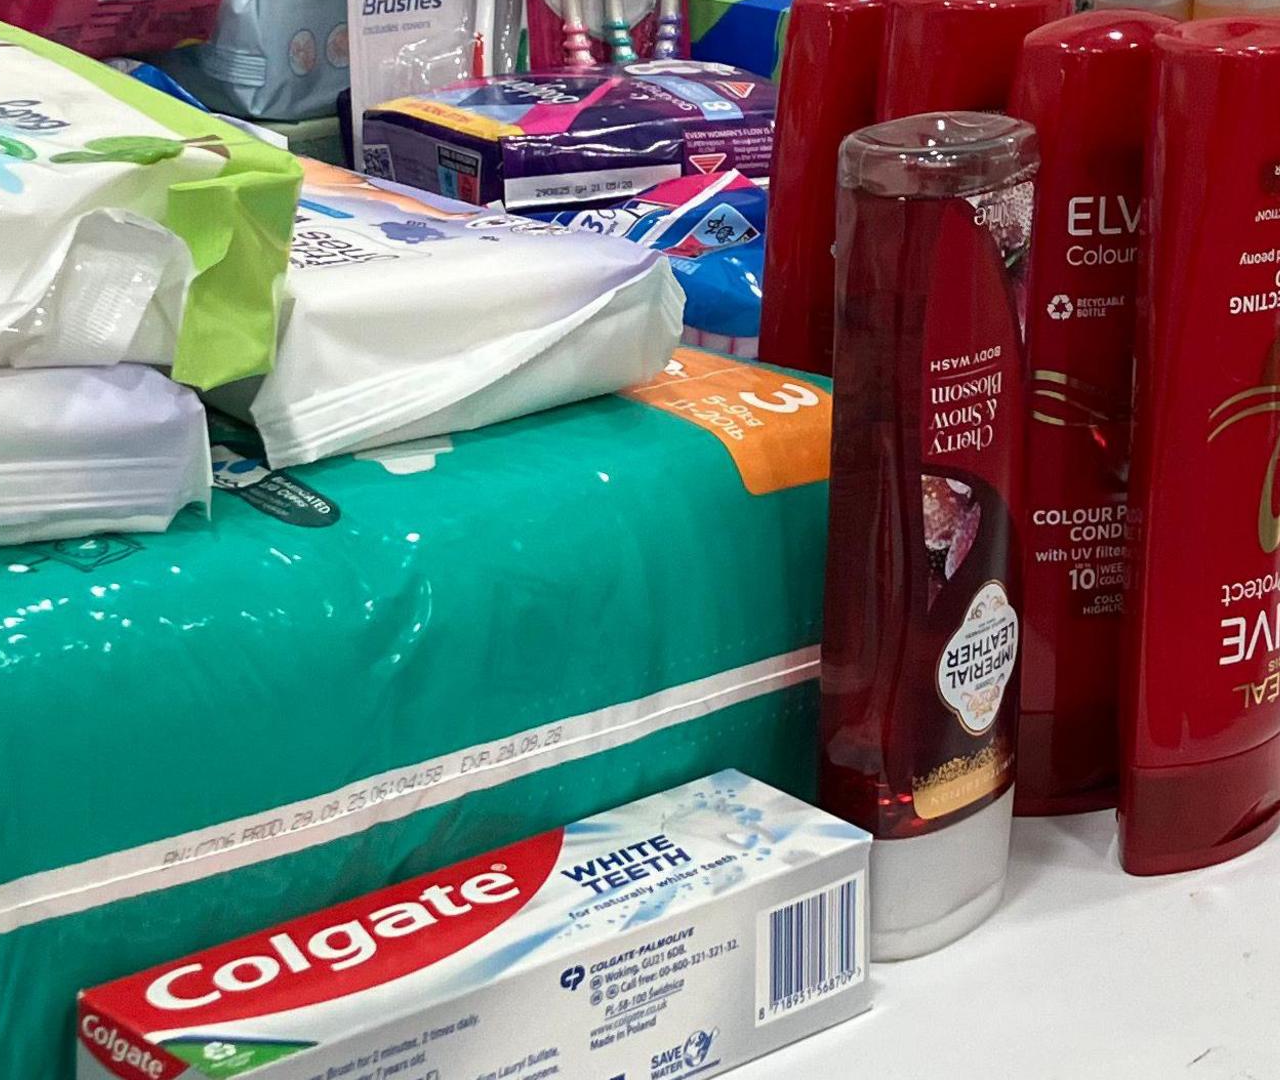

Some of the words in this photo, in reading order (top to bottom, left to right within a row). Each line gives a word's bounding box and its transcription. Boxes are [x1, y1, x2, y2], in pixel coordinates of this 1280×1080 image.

[684, 130, 707, 140] EVERY
[708, 128, 742, 139] WOMAN'S
[742, 127, 764, 137] FLOW
[1067, 244, 1138, 266] Colour
[1239, 247, 1275, 266] peony
[1076, 296, 1125, 308] RECYCLABLE
[1076, 308, 1107, 318] BOTTLE
[929, 355, 971, 372] WASH
[971, 345, 1002, 364] BODY
[738, 383, 819, 414] 3
[930, 371, 1002, 405] Blossom
[927, 403, 982, 430] Snow
[986, 398, 998, 419] &
[927, 424, 993, 456] Cherry
[1033, 507, 1113, 525] COLOUR
[1035, 549, 1068, 562] with
[1071, 547, 1093, 561] UV
[1068, 568, 1096, 591] 10
[946, 620, 1015, 669] LEATHER
[945, 643, 1014, 690] IMPERIAL
[560, 834, 674, 883] WHITE
[581, 847, 692, 895] TEETH
[568, 905, 591, 921] for
[593, 884, 655, 913] naturally
[655, 867, 699, 889] whiter
[700, 853, 738, 872] teeth
[145, 865, 521, 1011] Colgate
[589, 926, 696, 975] COLGATE-PALMOLIVE
[642, 951, 666, 970] GU21
[620, 975, 638, 993] Call
[773, 987, 812, 1014] 718951
[816, 969, 854, 996] 568709
[589, 1033, 616, 1051] Made
[616, 1029, 626, 1041] in
[626, 1015, 657, 1038] Poland
[81, 1013, 167, 1079] Colgate
[650, 1045, 683, 1070] SAVE
[325, 1061, 354, 1079] Brush
[355, 1054, 372, 1069] for
[494, 1056, 527, 1078] Lauryl
[650, 1060, 683, 1080] WATER
